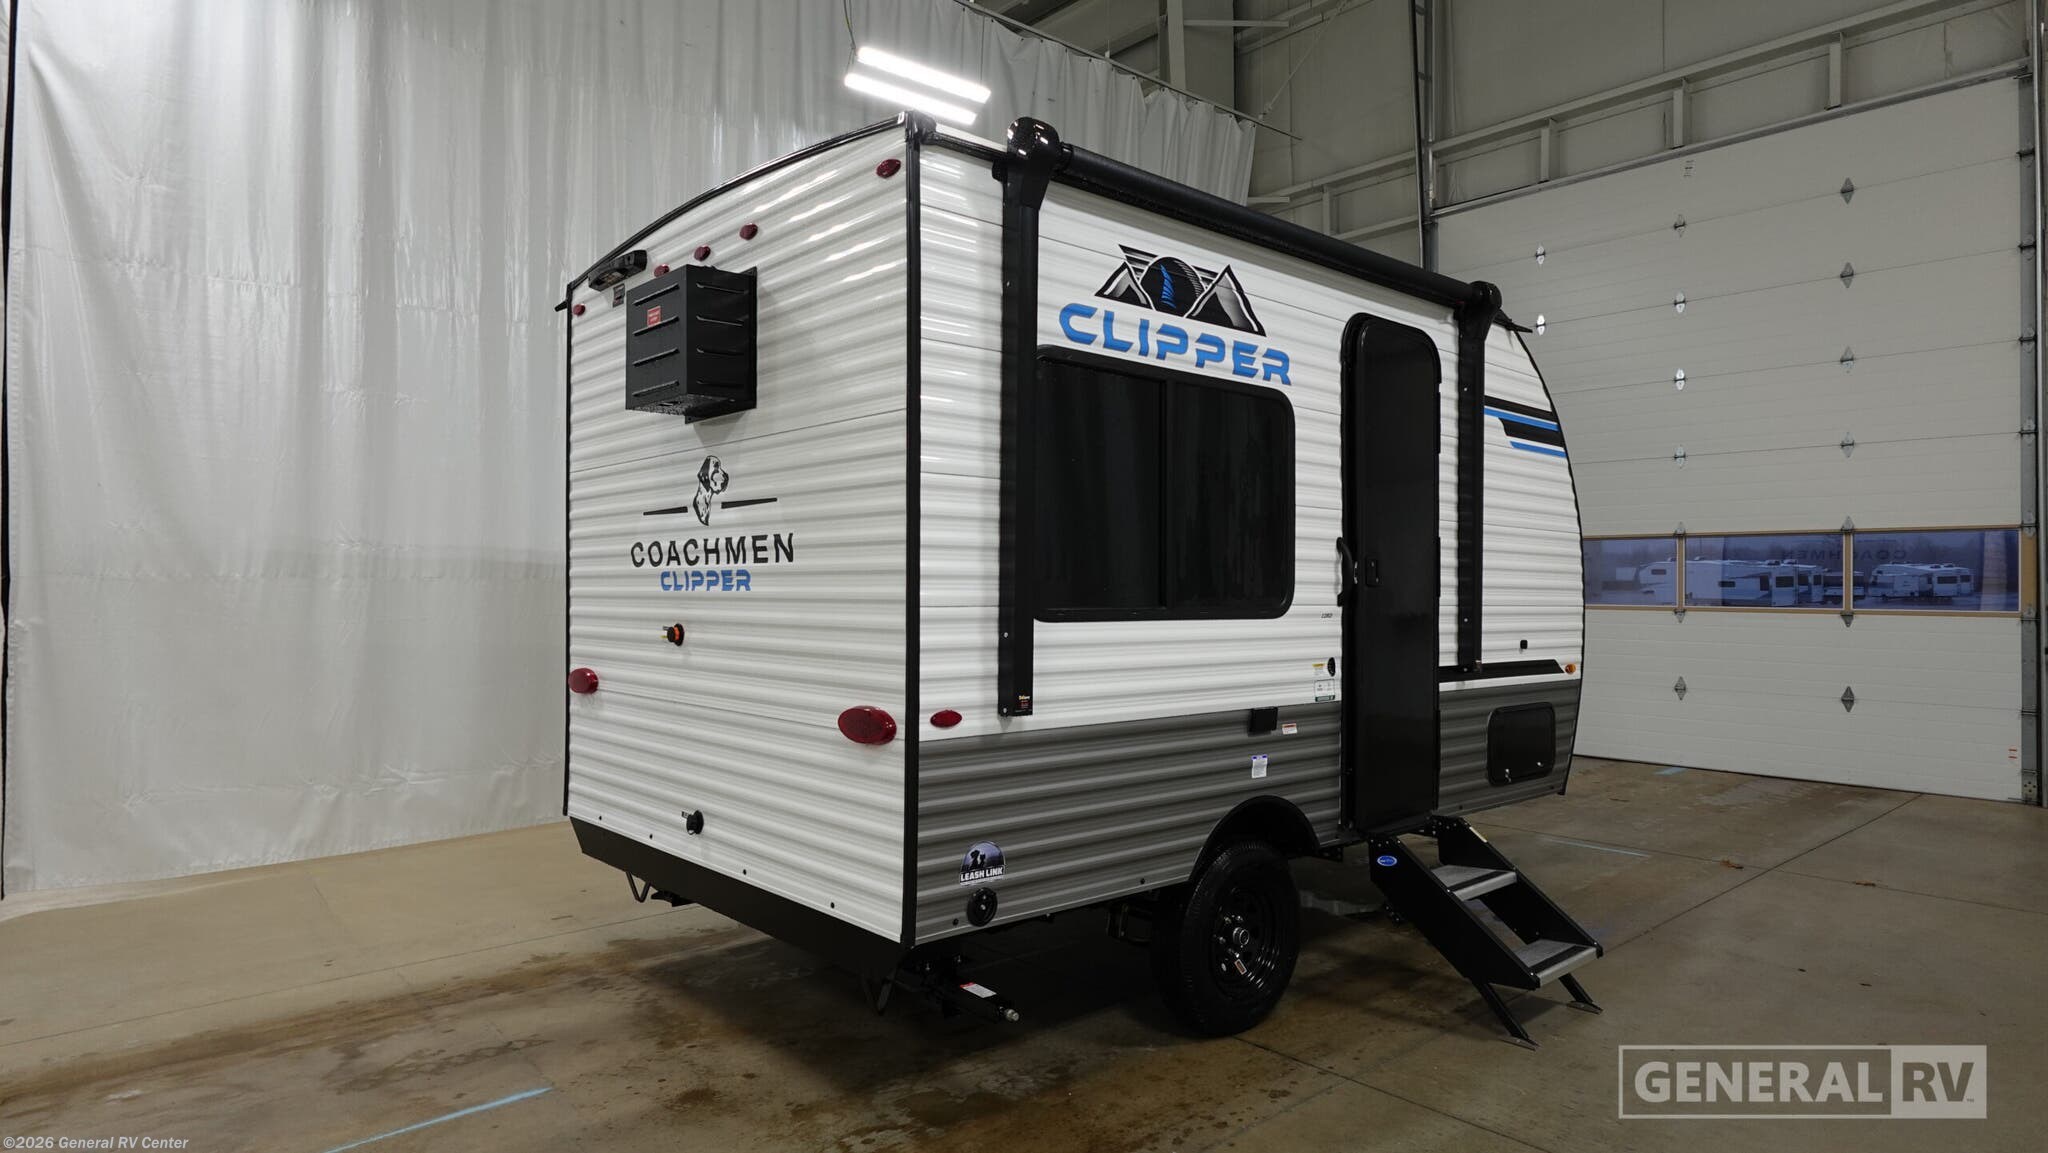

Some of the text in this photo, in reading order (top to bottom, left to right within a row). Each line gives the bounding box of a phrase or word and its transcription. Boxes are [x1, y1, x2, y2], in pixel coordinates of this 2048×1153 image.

[1059, 302, 1292, 386] CLIPPER
[630, 532, 794, 568] COACHMEN
[660, 568, 752, 592] CLIPPER
[960, 869, 985, 882] LEASH
[985, 866, 1003, 877] LINK
